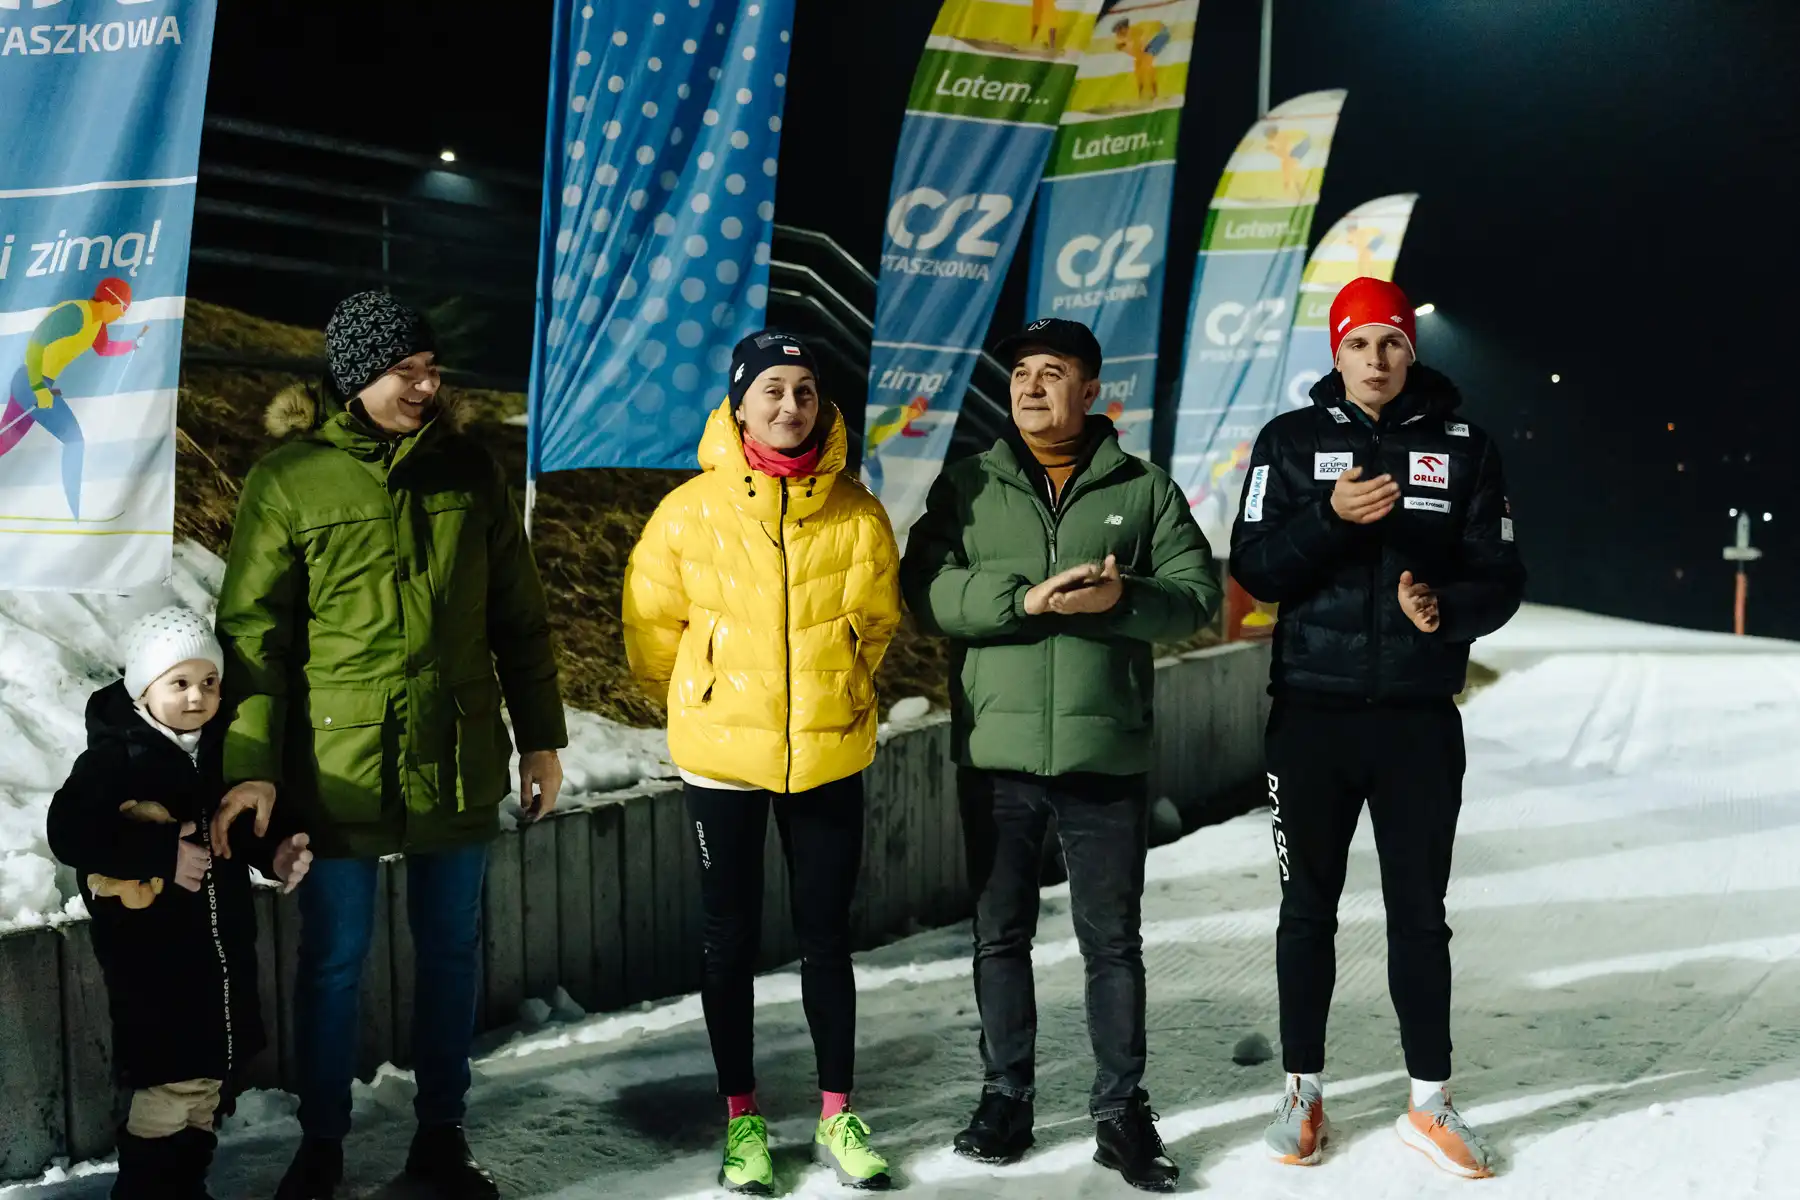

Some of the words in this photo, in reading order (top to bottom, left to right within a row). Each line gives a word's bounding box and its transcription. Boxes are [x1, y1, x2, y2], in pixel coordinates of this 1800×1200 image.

[935, 69, 1049, 105] Latem...
[25, 219, 162, 278] zimą!
[1100, 372, 1137, 403] mą!
[1250, 469, 1264, 507] DAIKIN
[1413, 474, 1445, 484] ORLEN
[696, 821, 709, 860] CRAFT
[1267, 771, 1289, 881] POLSKA
[208, 882, 216, 910] COOL
